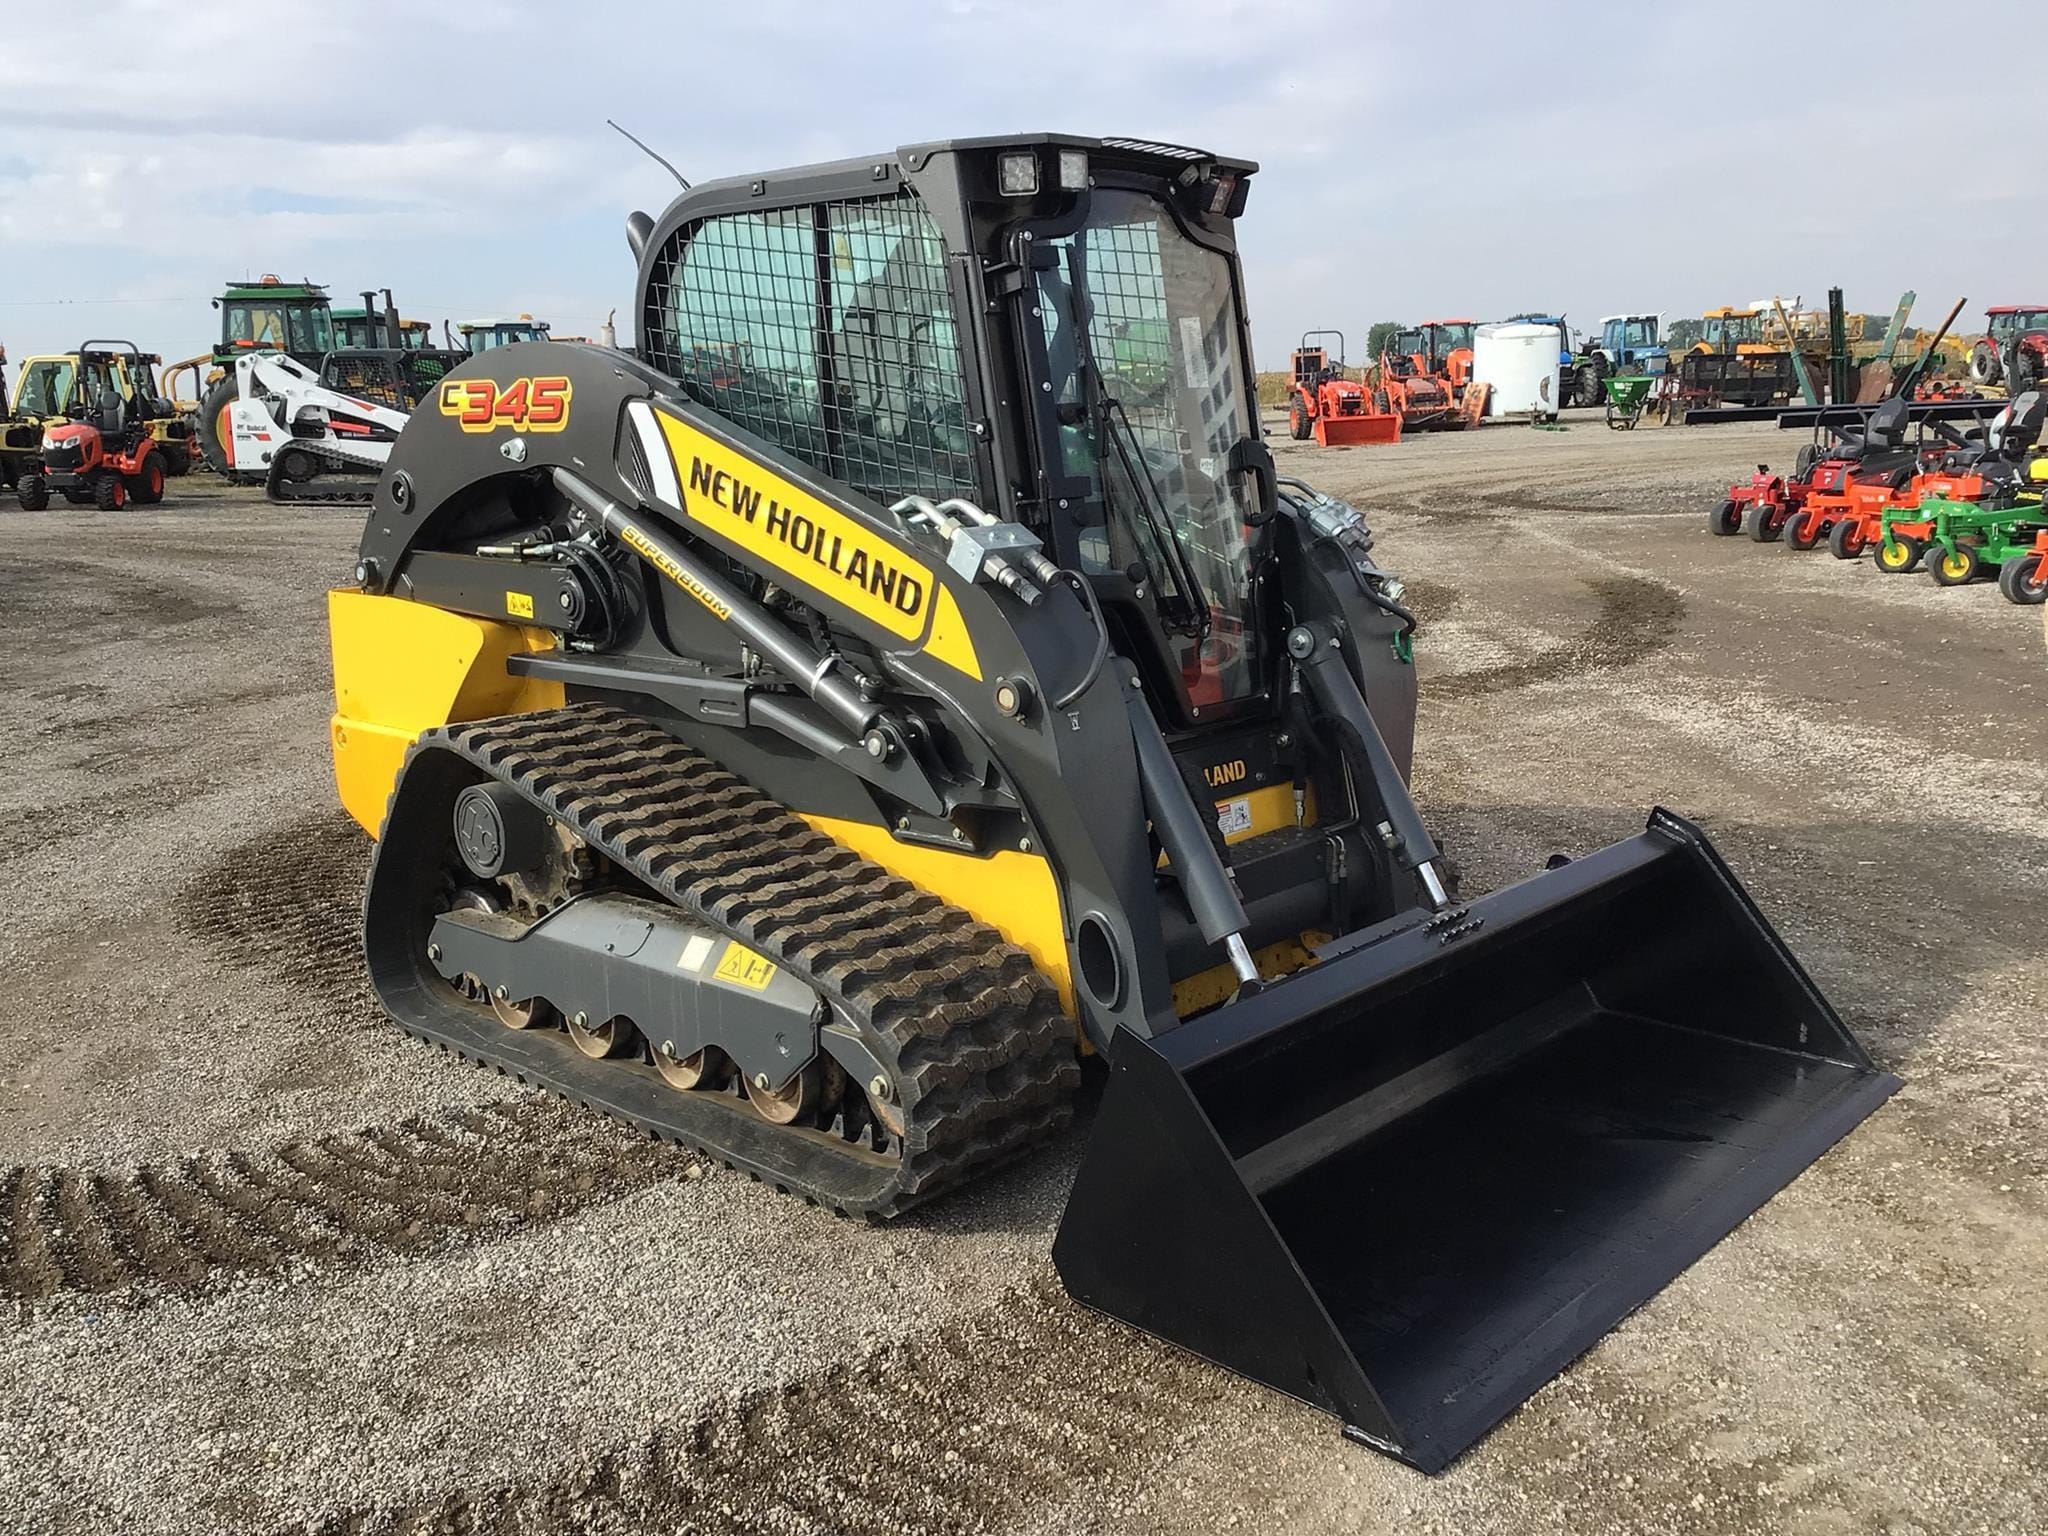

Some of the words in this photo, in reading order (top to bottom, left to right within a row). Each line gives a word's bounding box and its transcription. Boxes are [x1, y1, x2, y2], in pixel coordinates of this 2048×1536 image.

[440, 378, 571, 431] C345
[690, 456, 761, 524] NEW
[766, 500, 922, 617] HOLLAND
